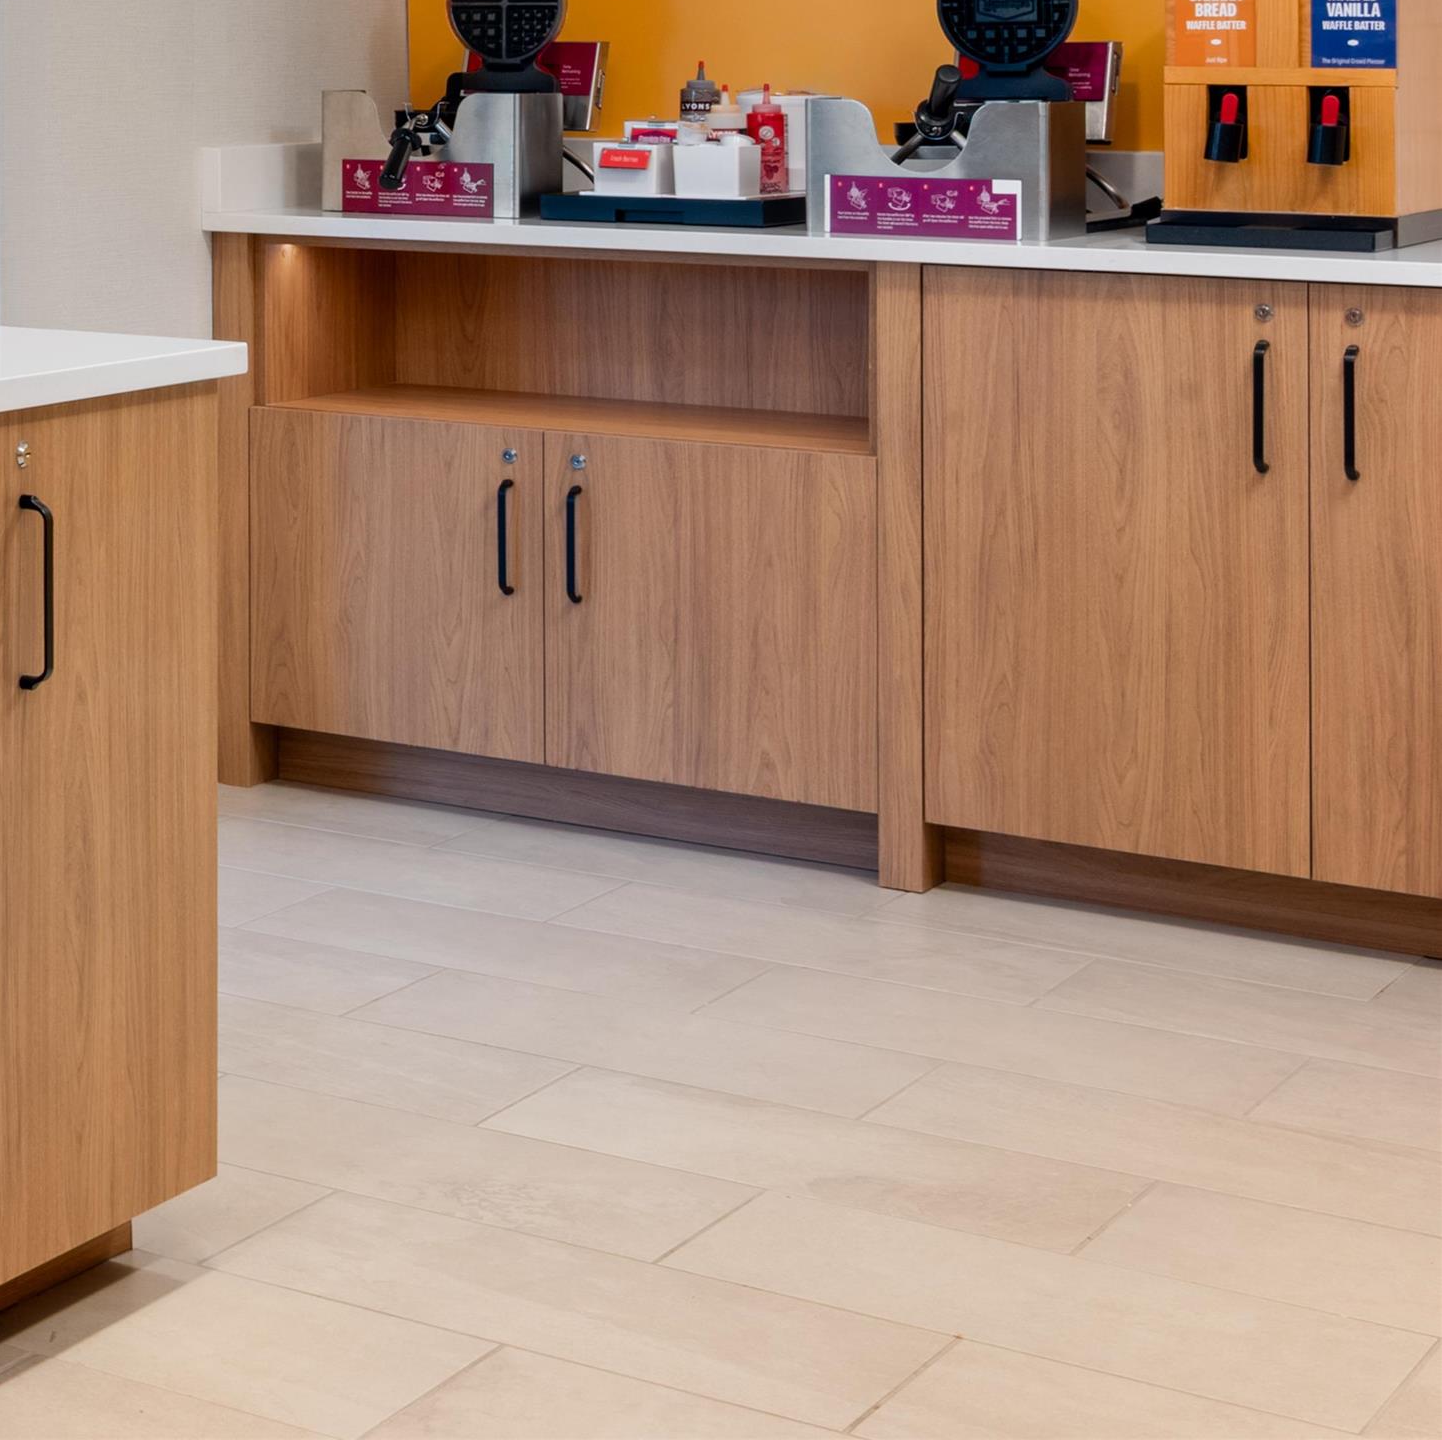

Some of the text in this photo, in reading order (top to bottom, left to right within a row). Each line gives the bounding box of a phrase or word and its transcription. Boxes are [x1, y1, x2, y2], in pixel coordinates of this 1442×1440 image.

[1194, 2, 1238, 18] BREAD
[1326, 2, 1382, 18] VANILLA
[1185, 19, 1247, 31] WAFFLE BATTER
[1321, 20, 1386, 31] WAFFLE BATTER
